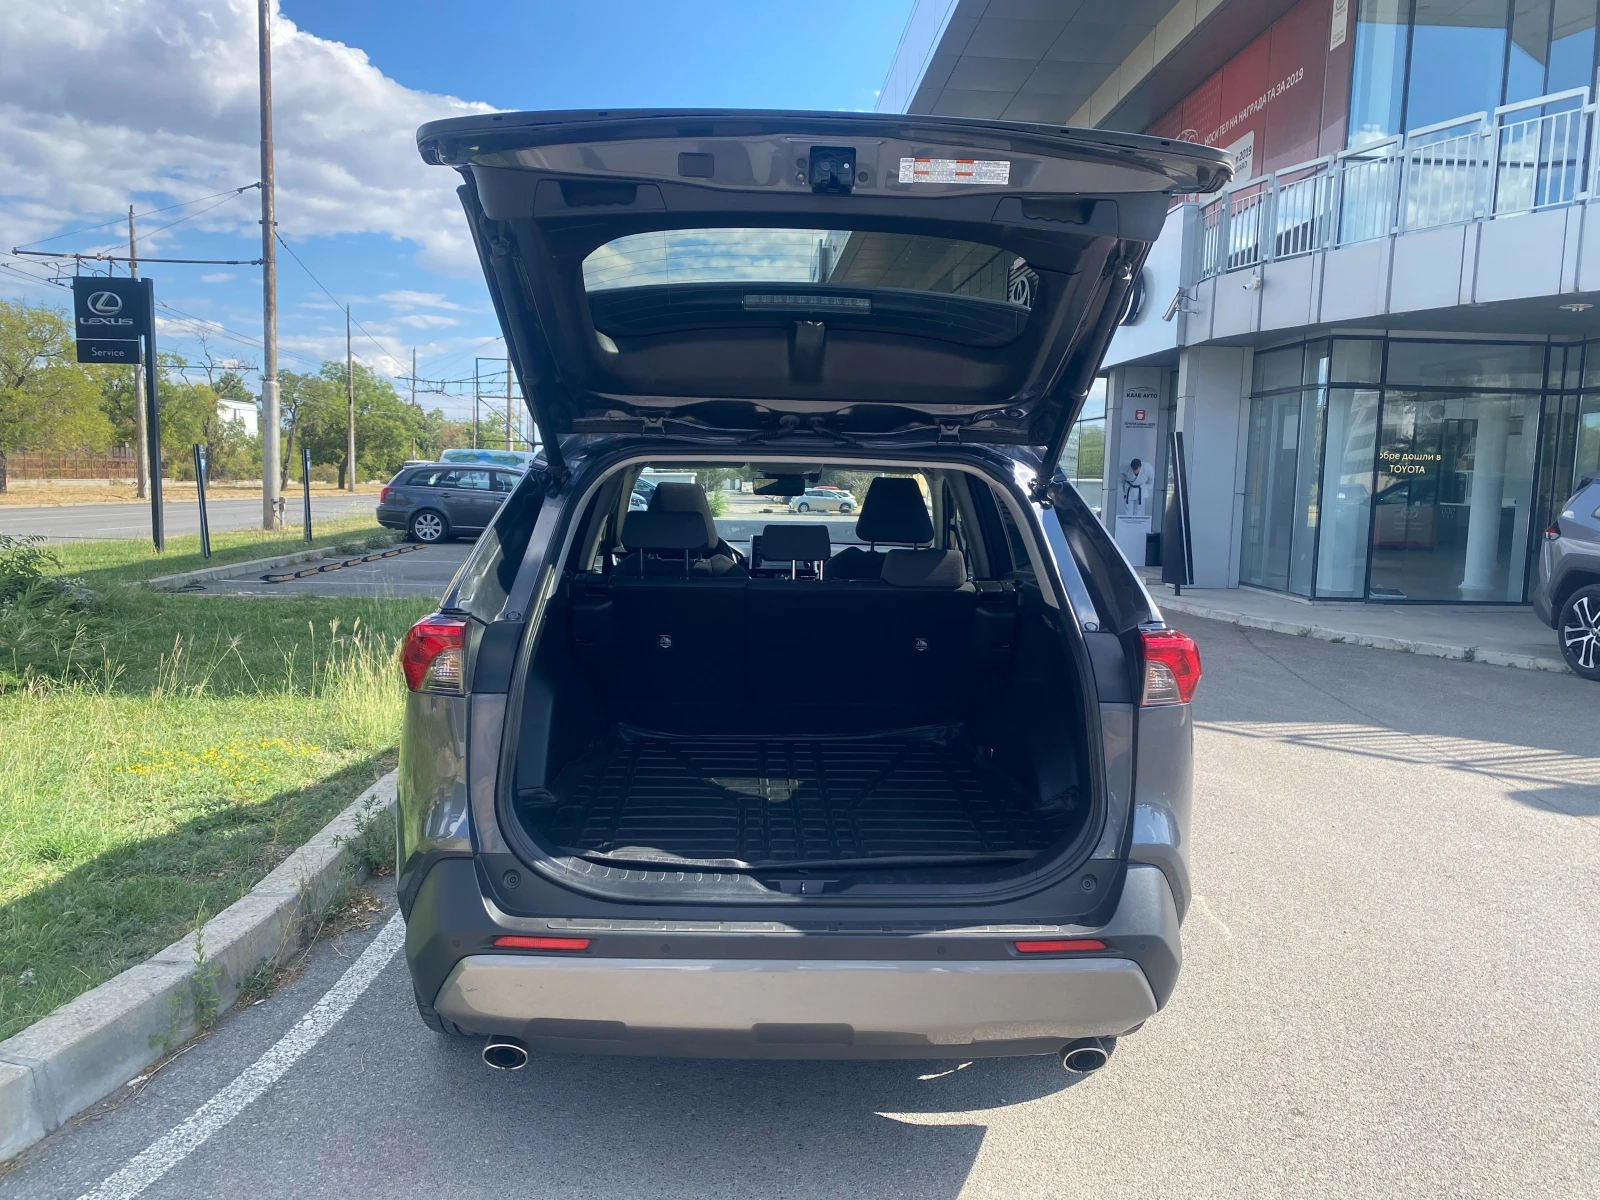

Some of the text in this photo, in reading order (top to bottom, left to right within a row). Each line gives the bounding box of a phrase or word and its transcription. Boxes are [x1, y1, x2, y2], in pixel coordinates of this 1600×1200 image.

[1286, 67, 1304, 89] 2019
[80, 317, 133, 325] LEXUS
[91, 347, 125, 357] Service
[1401, 453, 1434, 462] дошли
[1389, 464, 1426, 474] TOYOTA
